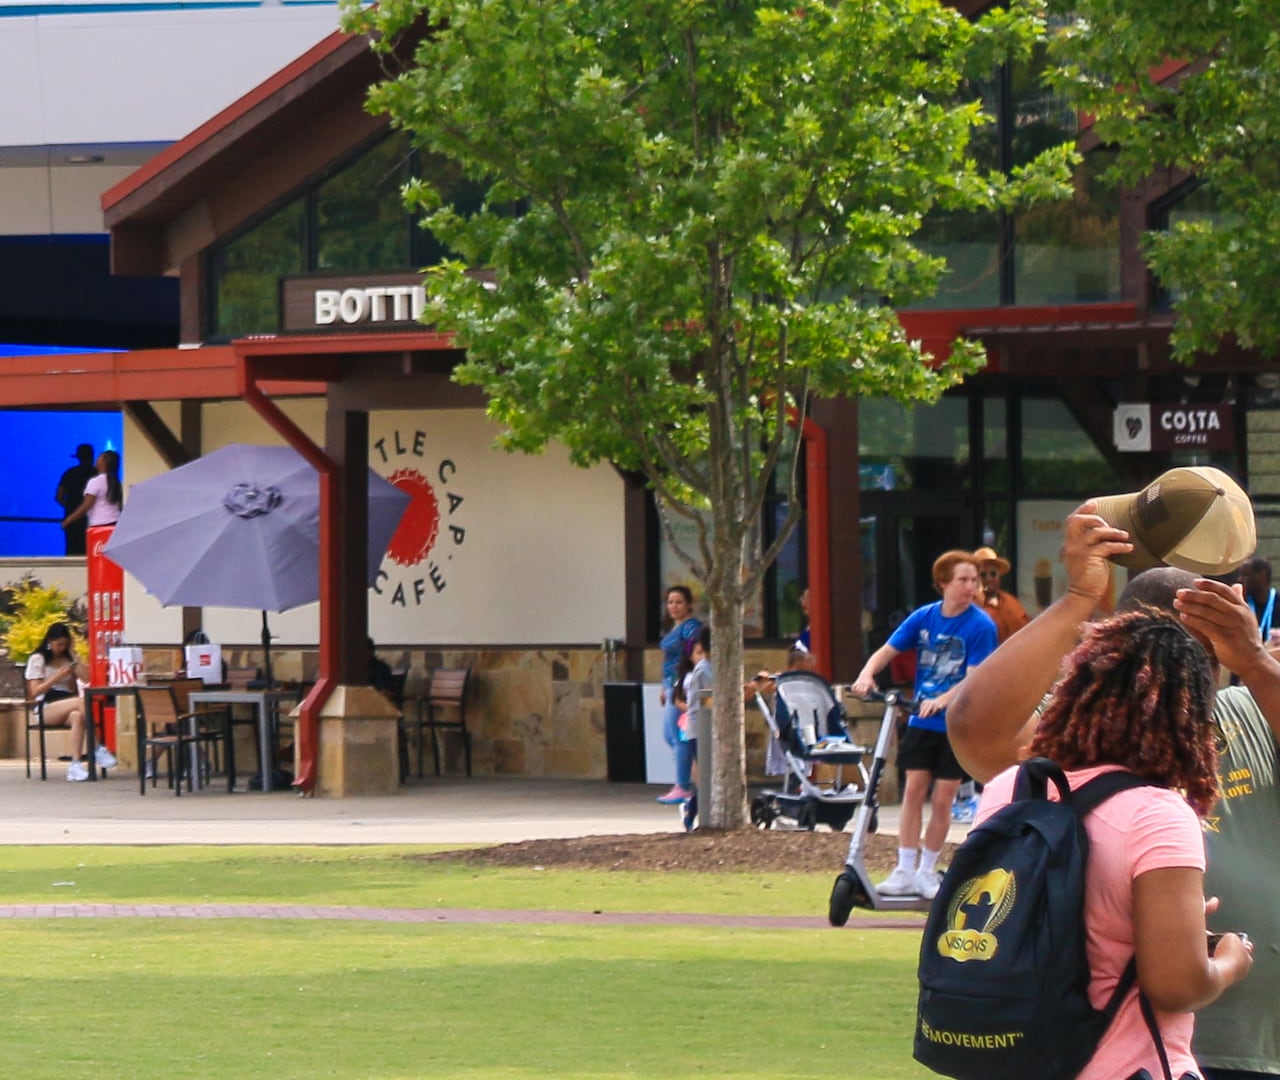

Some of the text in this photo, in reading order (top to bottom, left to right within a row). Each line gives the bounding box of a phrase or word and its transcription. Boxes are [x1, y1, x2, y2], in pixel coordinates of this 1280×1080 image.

[1161, 410, 1220, 432] COSTA
[1175, 434, 1208, 444] COFFEE
[946, 934, 988, 953] VISIONS
